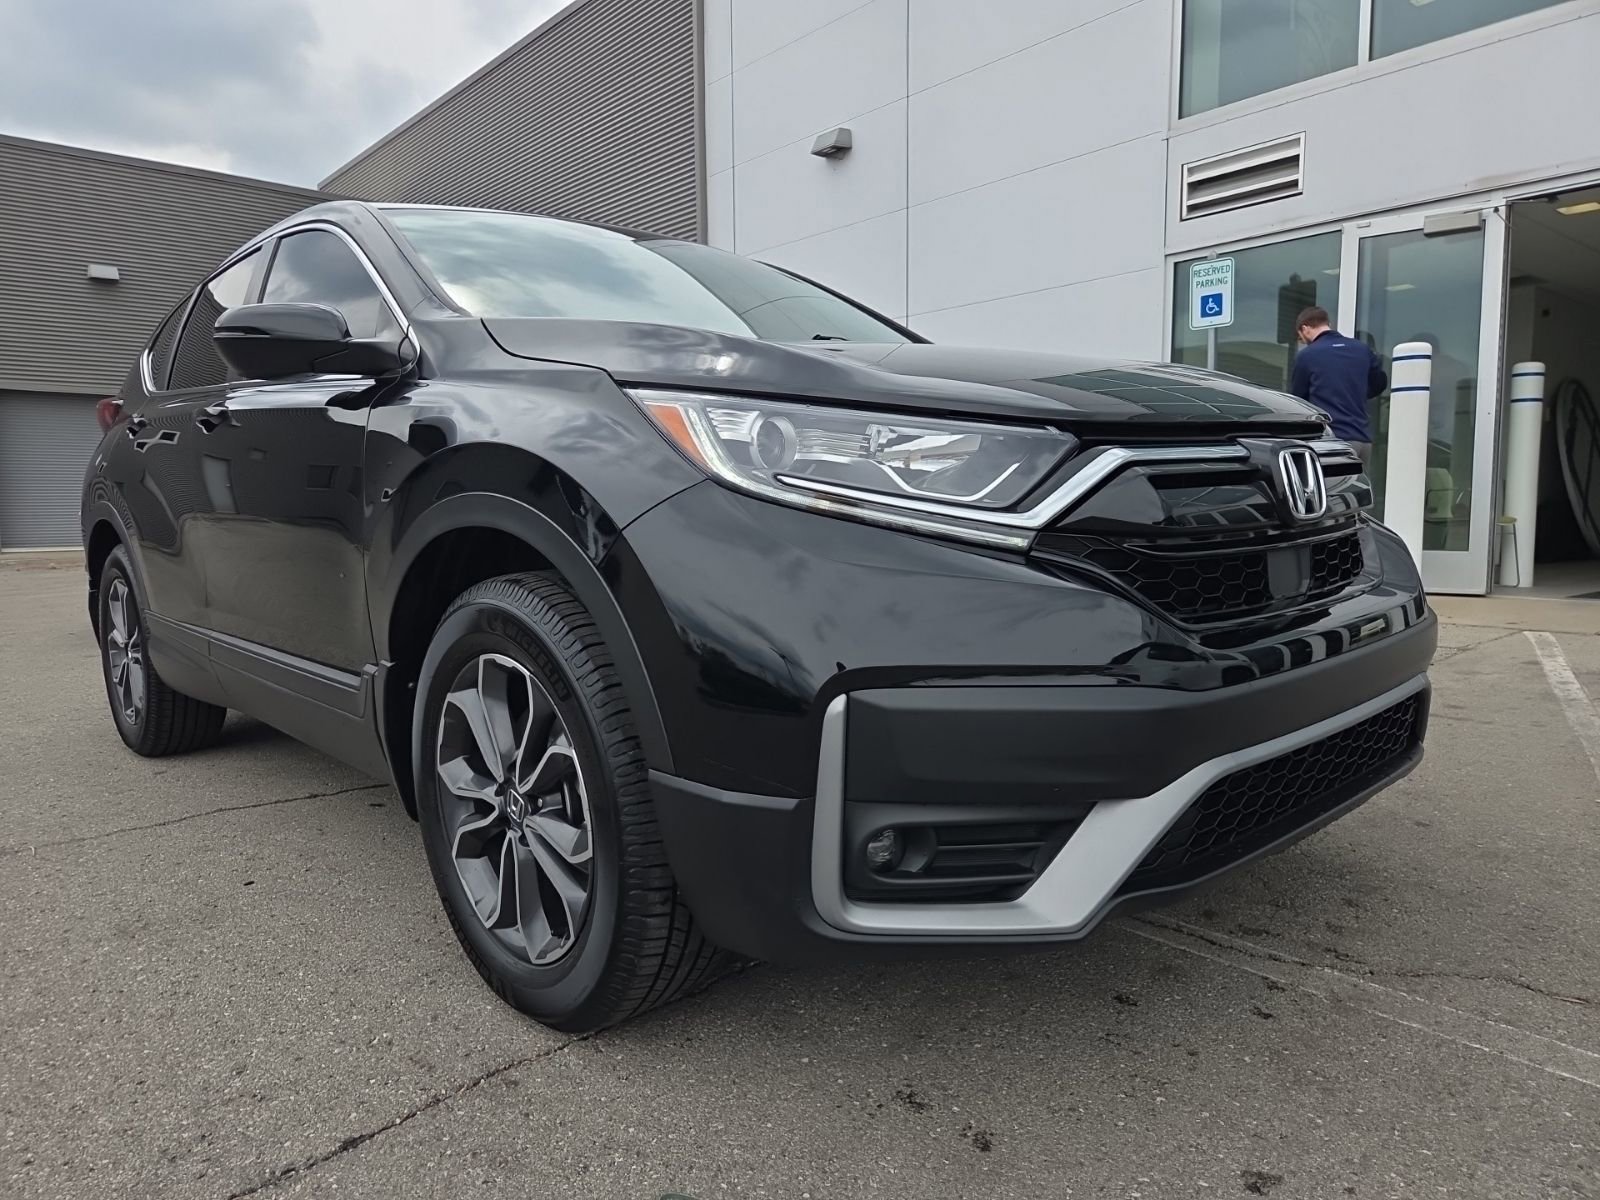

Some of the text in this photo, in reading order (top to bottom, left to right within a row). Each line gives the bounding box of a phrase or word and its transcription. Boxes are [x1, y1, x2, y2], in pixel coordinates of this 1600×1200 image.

[1193, 265, 1231, 278] RESERVED
[1195, 277, 1229, 288] PARKING
[501, 620, 572, 699] MICHELIN
